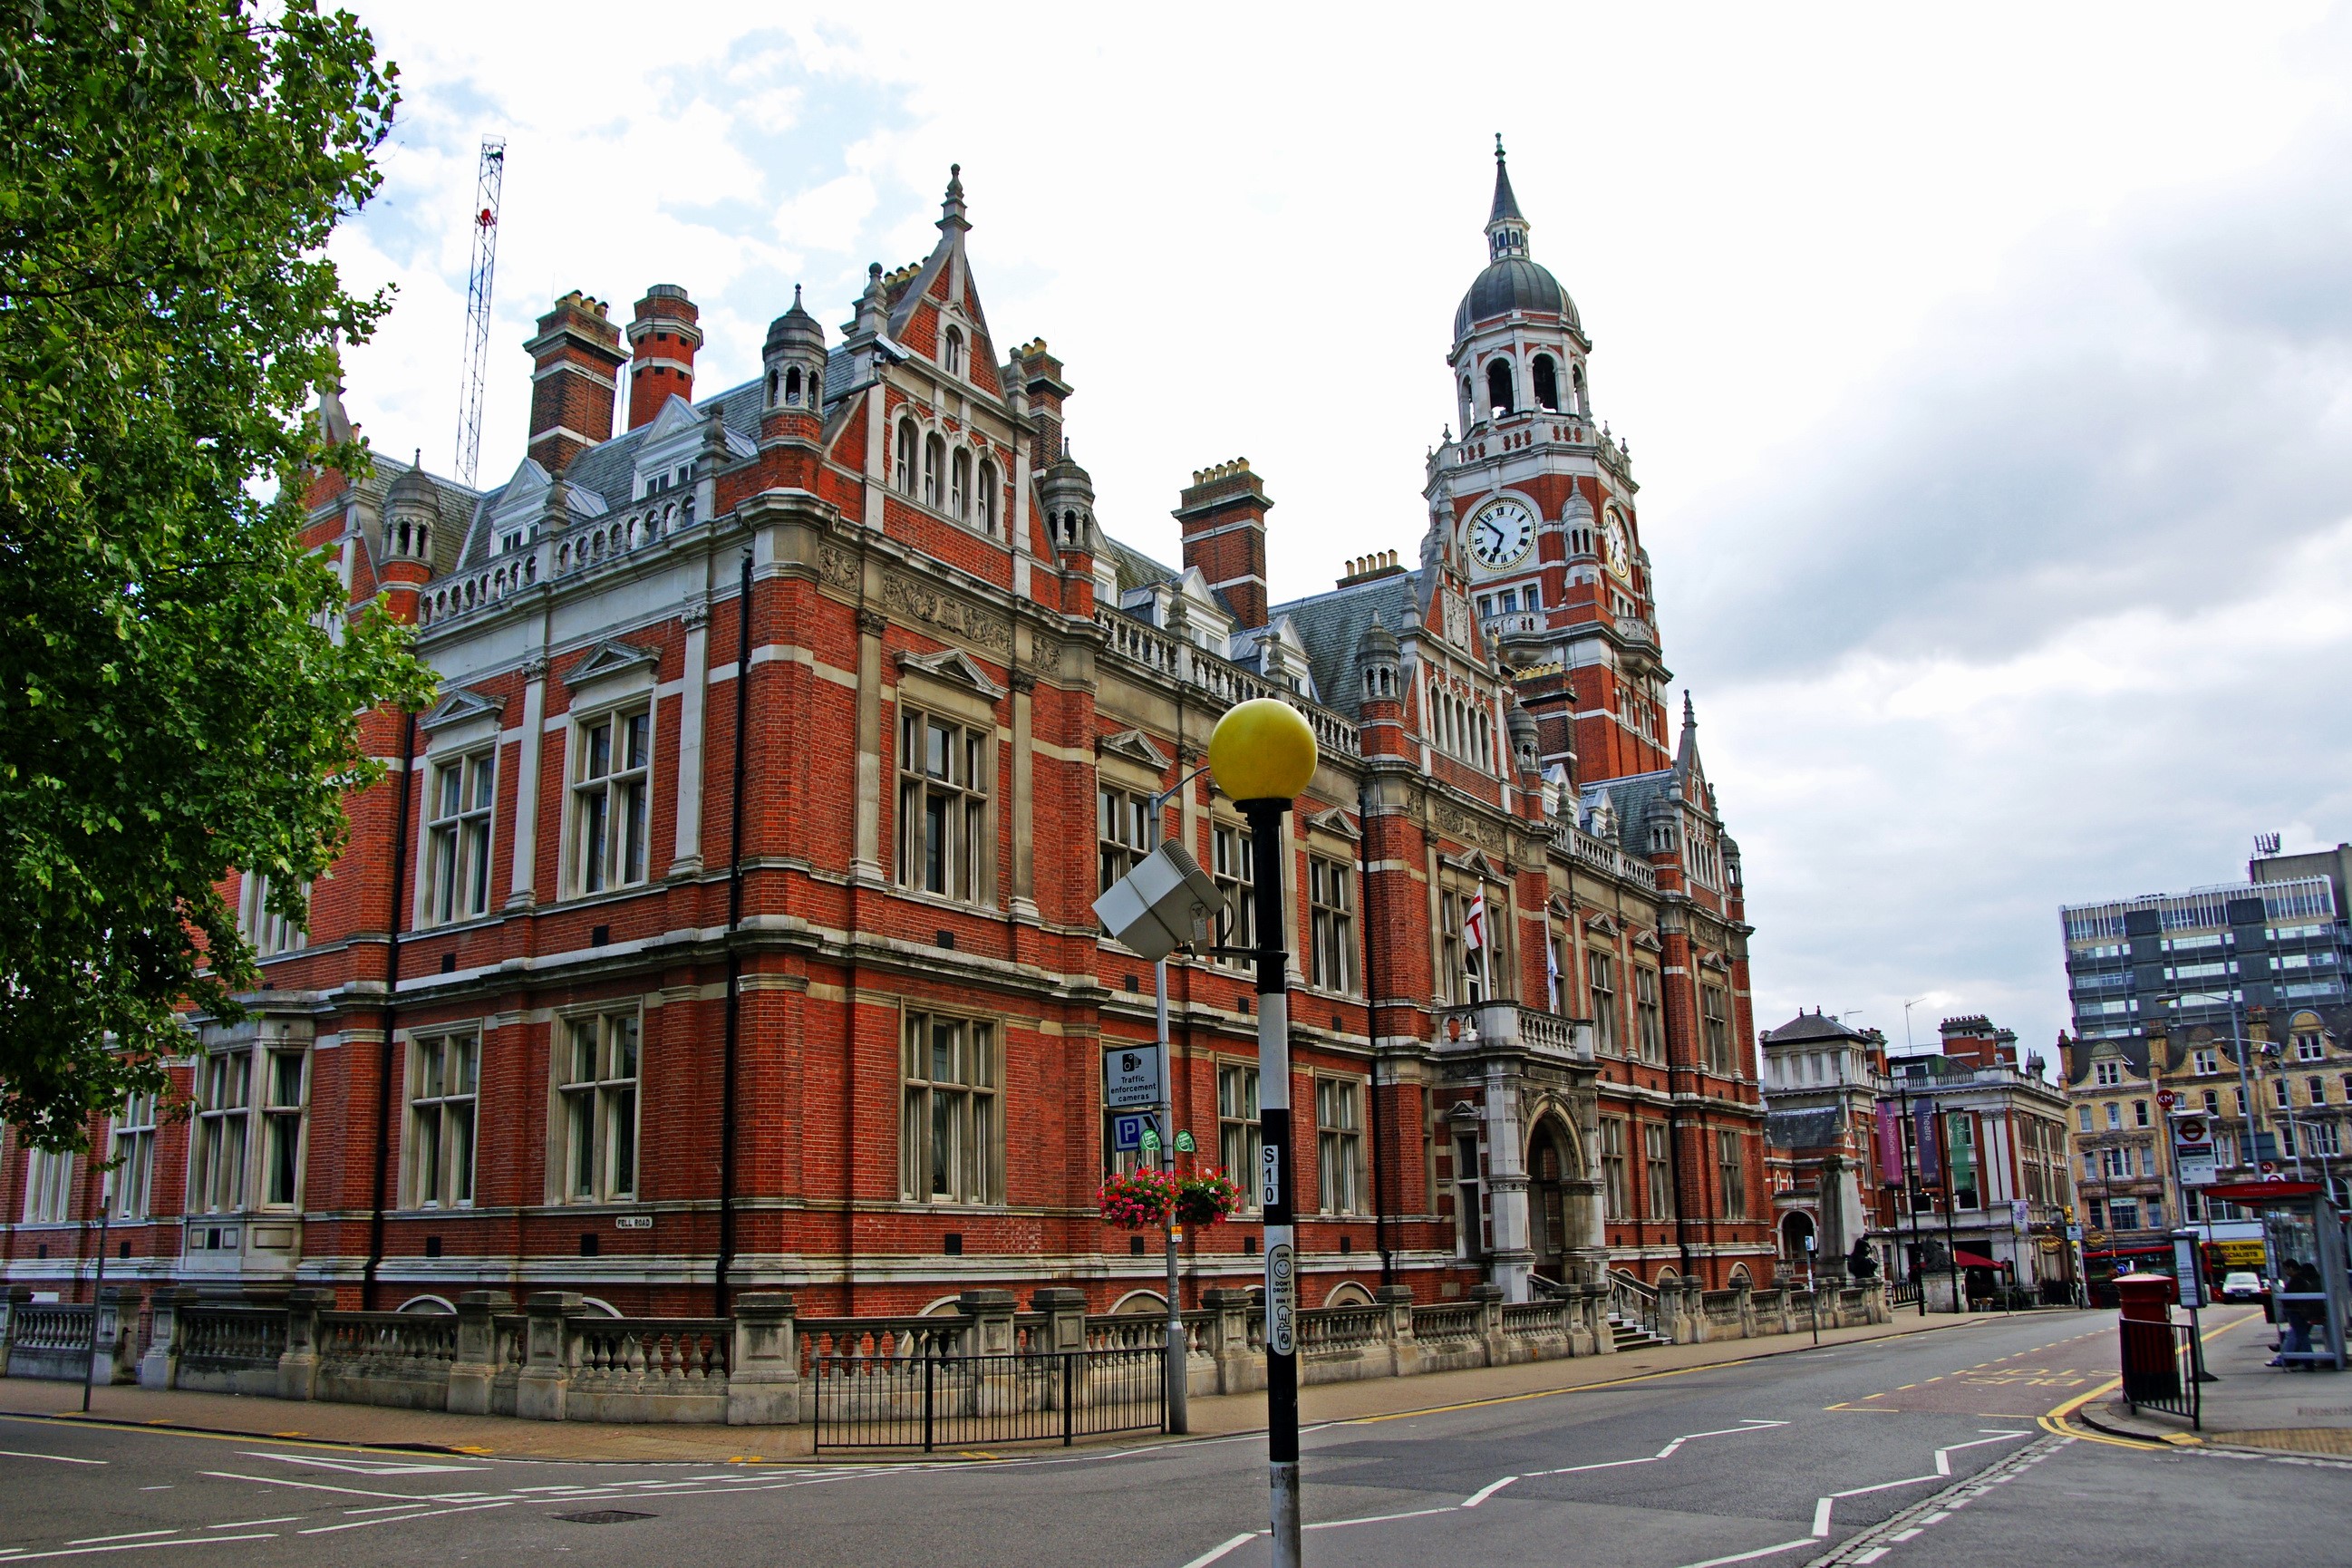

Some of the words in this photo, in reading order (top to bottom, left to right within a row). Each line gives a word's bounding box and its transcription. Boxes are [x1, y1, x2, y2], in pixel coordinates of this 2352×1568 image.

[1121, 1075, 1145, 1084] Traffic
[1110, 1082, 1157, 1094] enforcement
[1118, 1093, 1149, 1102] cameras
[2158, 1094, 2173, 1103] KM
[1124, 1121, 1137, 1141] P
[1922, 1110, 1932, 1142] Theatre
[1885, 1113, 1896, 1156] Exhibitions
[1956, 1123, 1964, 1146] Music
[618, 1219, 633, 1227] FELL
[634, 1218, 651, 1226] ROAD
[1960, 1377, 2085, 1386] BUS
